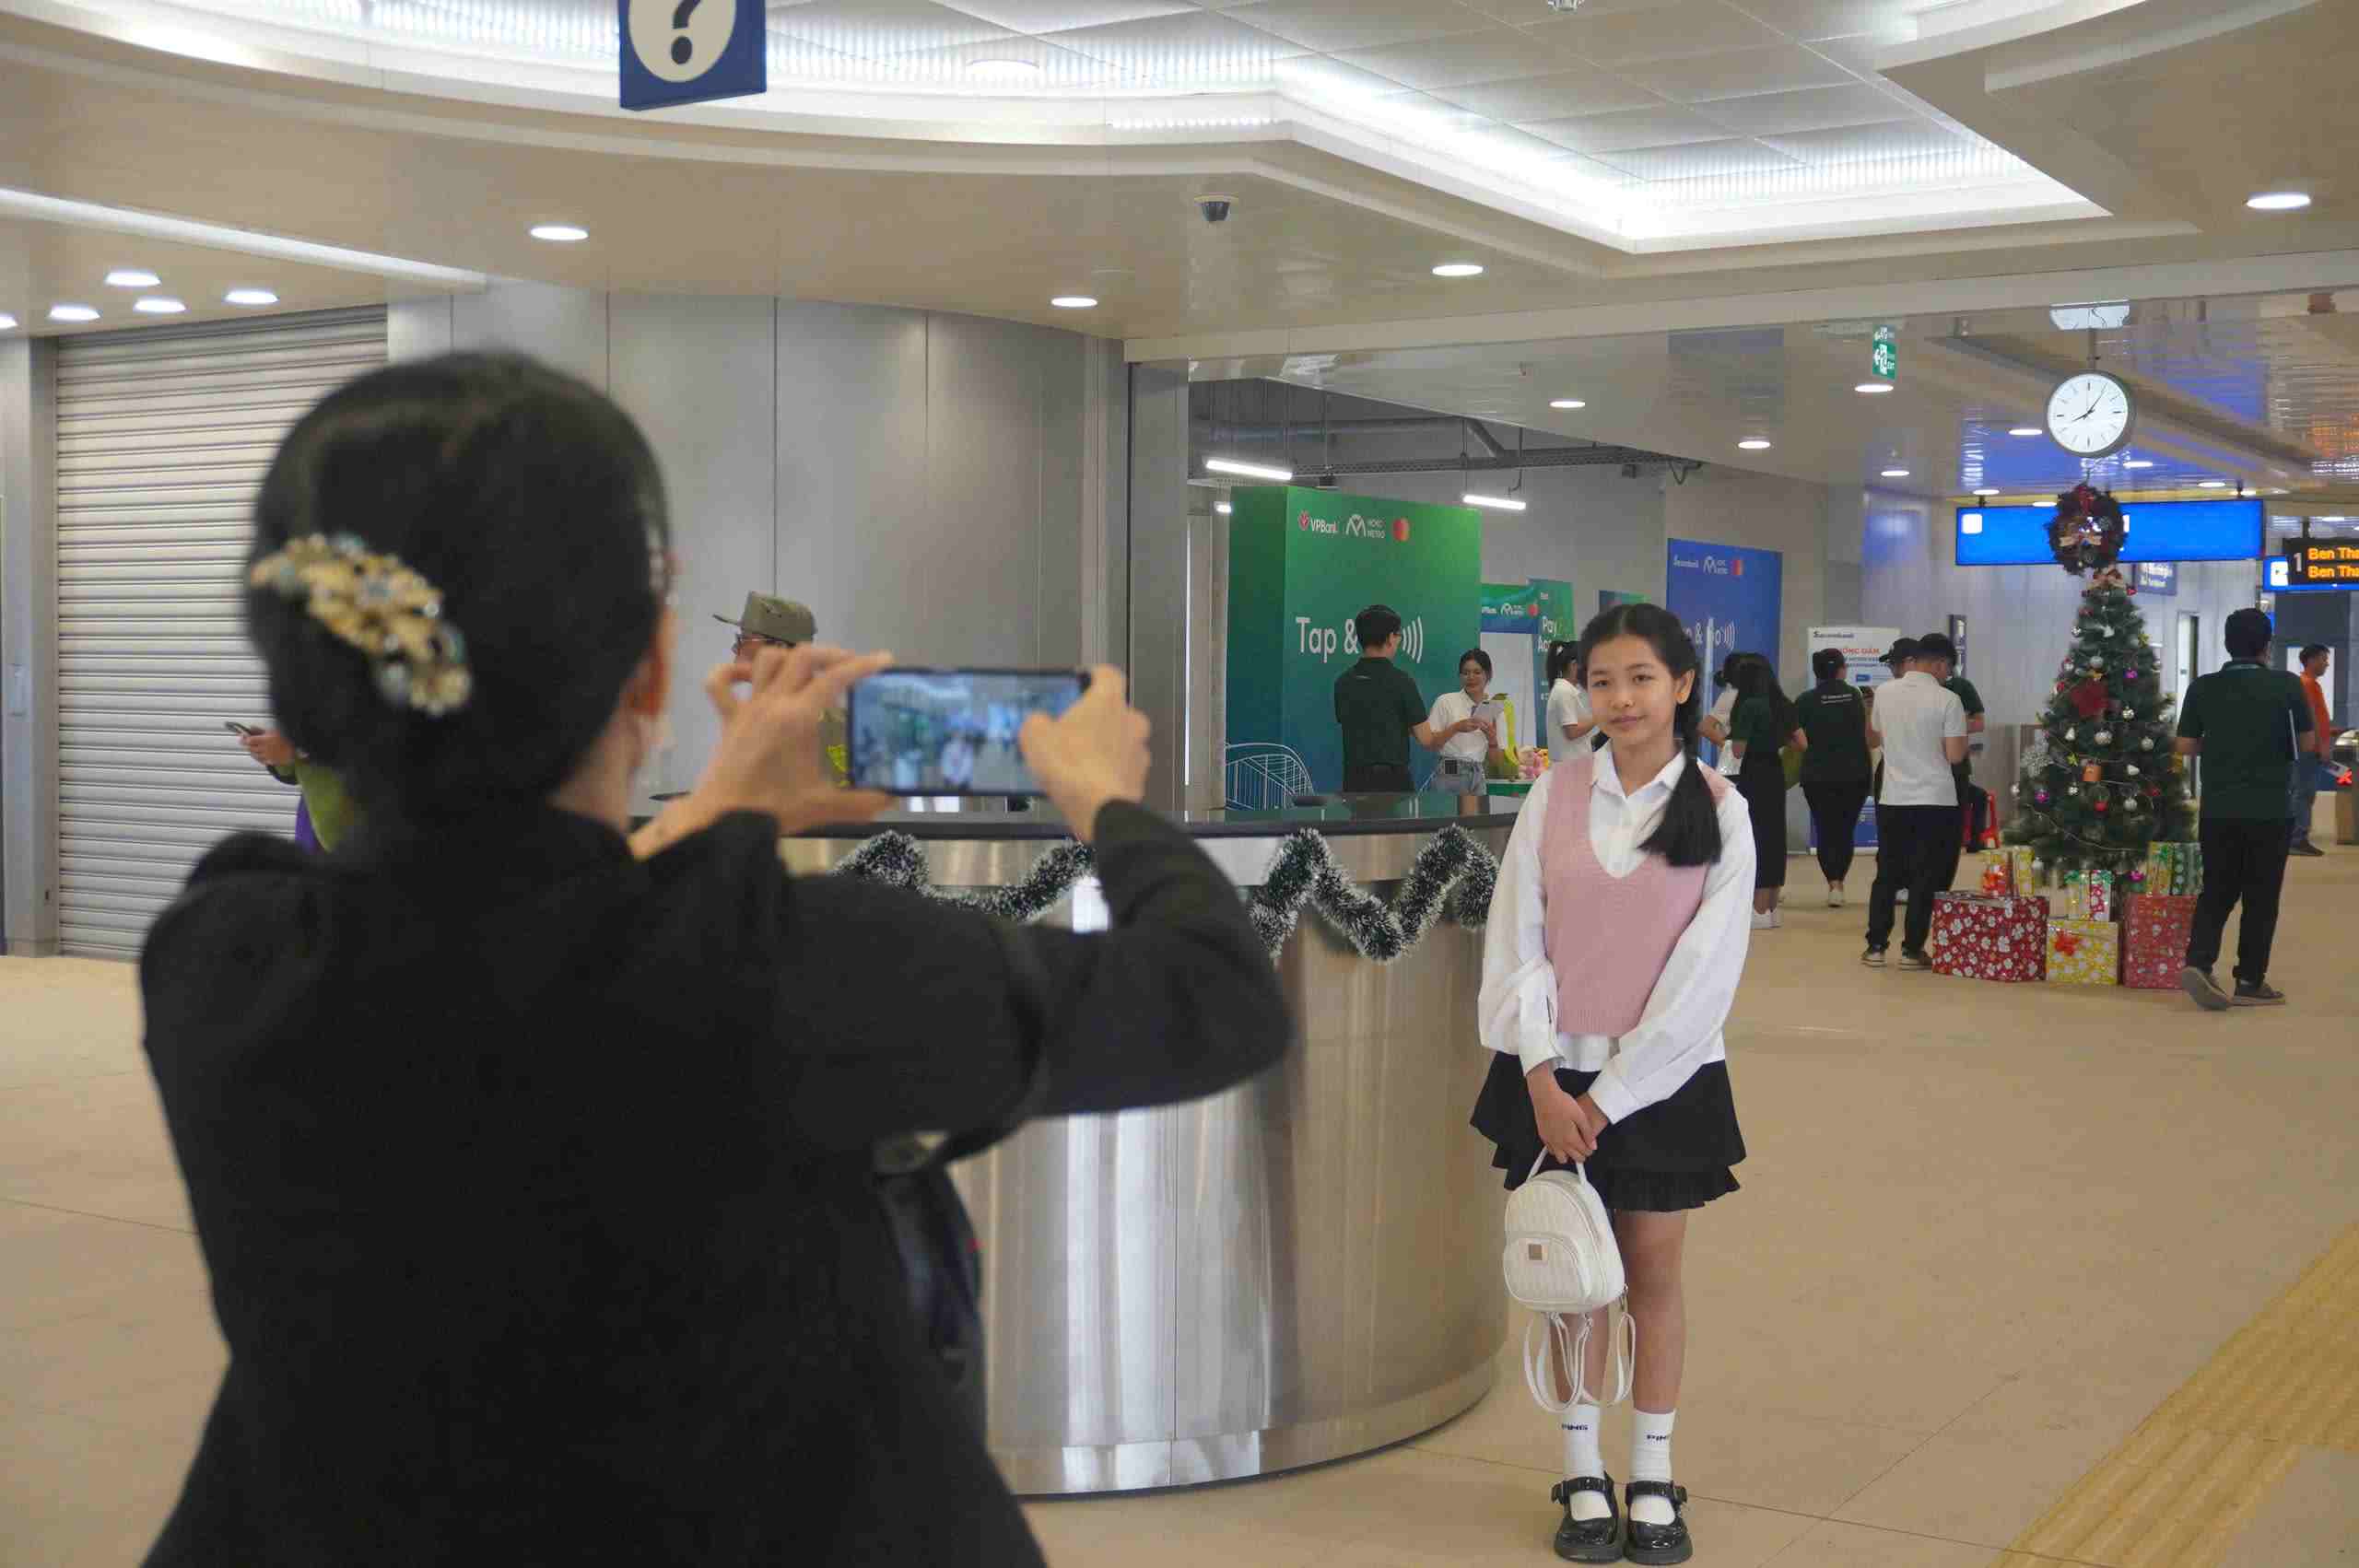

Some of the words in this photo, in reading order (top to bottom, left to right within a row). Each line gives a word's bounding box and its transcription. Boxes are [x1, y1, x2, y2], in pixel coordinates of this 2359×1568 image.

[2308, 547, 2335, 560] Ben
[2308, 566, 2335, 579] Ben
[1296, 616, 1336, 663] Tap
[1344, 618, 1359, 654] &
